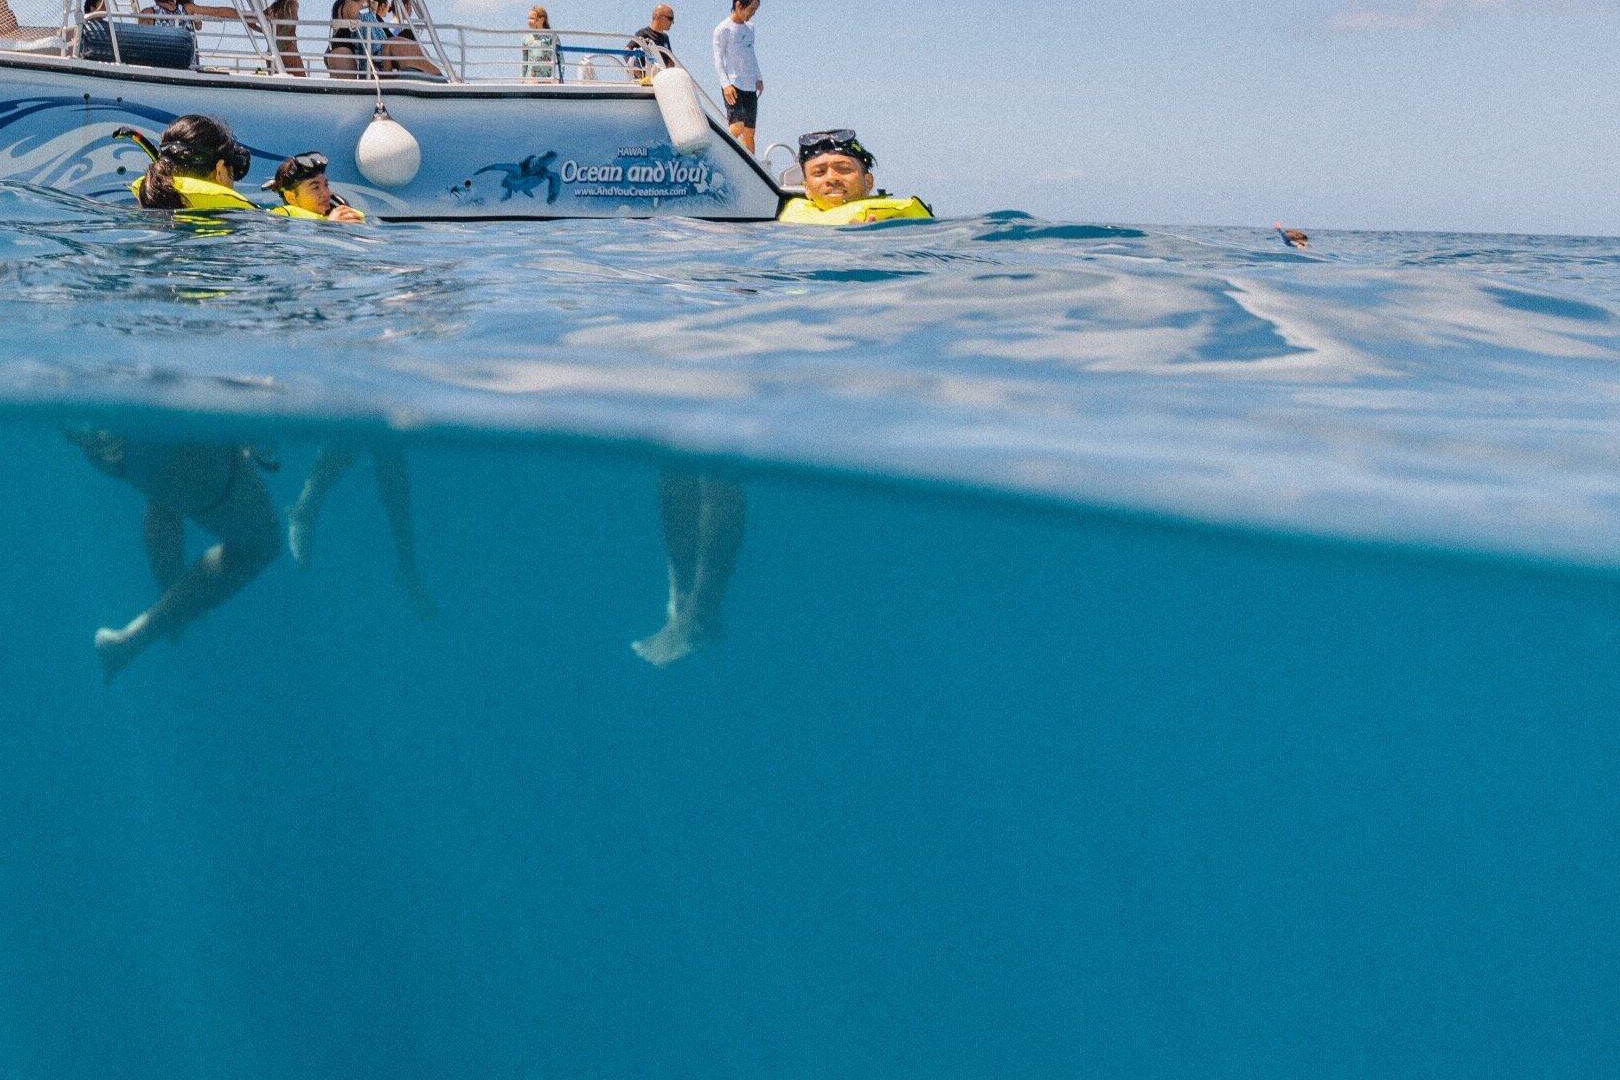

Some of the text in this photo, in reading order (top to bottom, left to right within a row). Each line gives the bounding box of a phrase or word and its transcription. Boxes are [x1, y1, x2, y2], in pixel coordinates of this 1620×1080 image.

[617, 147, 648, 158] HAWAII
[561, 160, 623, 183] Ocean
[627, 161, 665, 184] and
[574, 186, 687, 197] www.AndYouCreations.com
